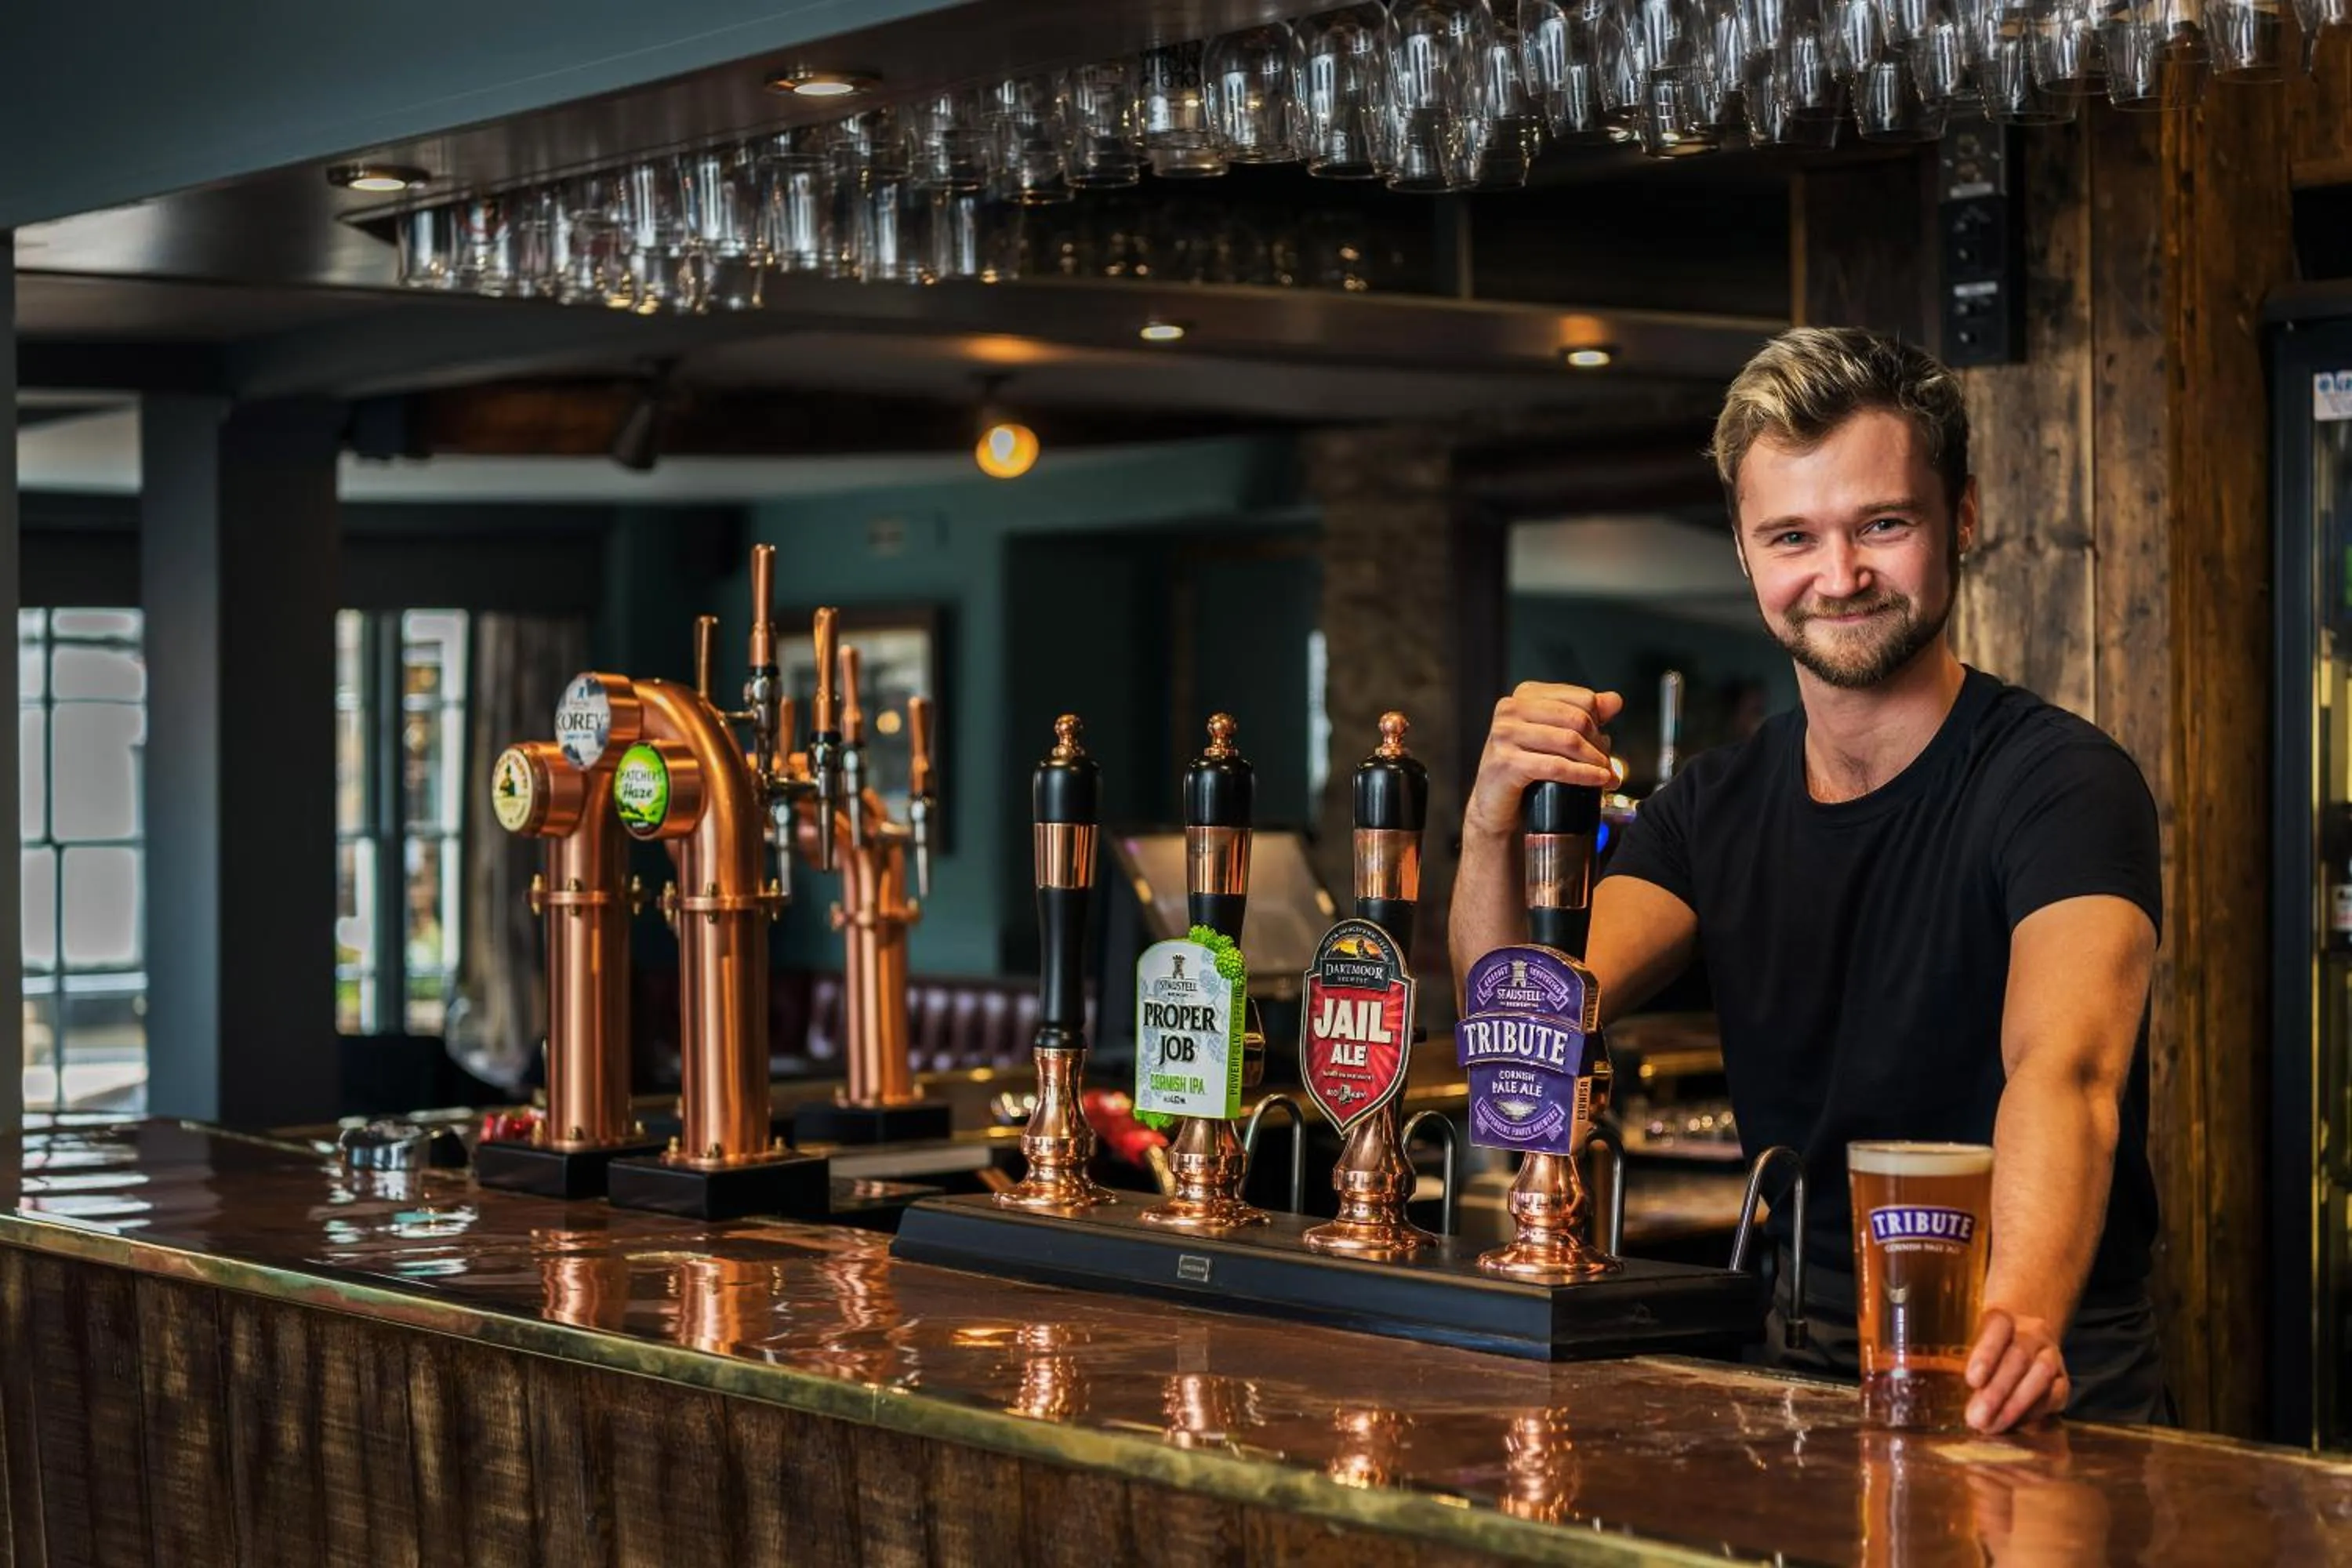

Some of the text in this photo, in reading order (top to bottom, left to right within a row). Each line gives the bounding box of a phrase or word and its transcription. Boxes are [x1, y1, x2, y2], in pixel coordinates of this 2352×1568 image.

[1326, 963, 1383, 980] DARTMOOR
[1143, 1001, 1216, 1032] PROPER
[1314, 997, 1392, 1044] JAIL
[1159, 1033, 1196, 1065] JOB
[1330, 1044, 1367, 1066] ALE
[1464, 1020, 1569, 1065] TRIBUTE
[1150, 1073, 1206, 1094] CORNISH IPA
[1498, 1070, 1536, 1081] CORNISH
[1492, 1081, 1543, 1098] PALE ALE
[1873, 1210, 1973, 1239] TRIBUTE
